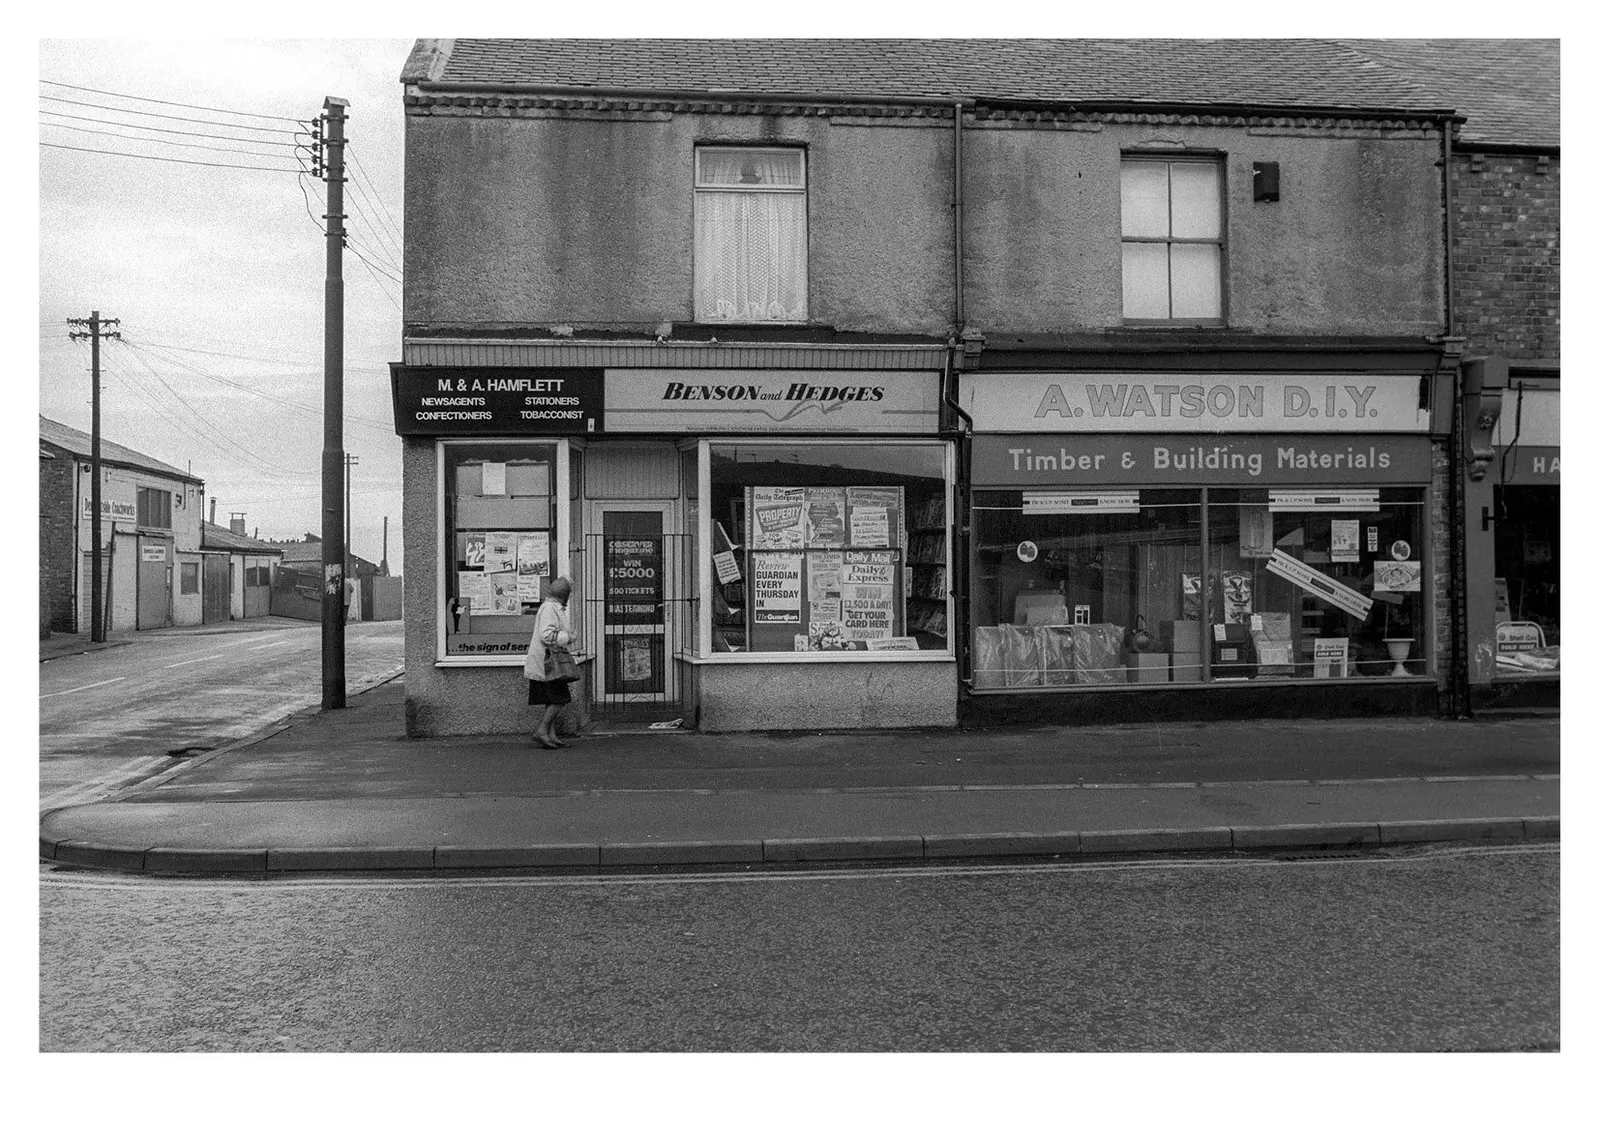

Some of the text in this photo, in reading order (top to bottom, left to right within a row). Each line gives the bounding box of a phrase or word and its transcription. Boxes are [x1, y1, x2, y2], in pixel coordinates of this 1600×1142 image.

[438, 378, 564, 392] M. & A. HAMFLETT
[662, 382, 885, 402] BENSON and HEDGES
[421, 397, 486, 407] NEWSAGENTS
[525, 396, 580, 406] STATIONERS
[1283, 385, 1378, 419] D.I.Y.
[415, 411, 493, 421] CONFECTIONERS
[520, 410, 584, 420] TOBACCONIST
[1008, 446, 1391, 477] Timber & Building Materials
[773, 493, 804, 502] Telegraph
[759, 506, 802, 524] PROPERTY
[847, 551, 891, 563] Daily Mail
[756, 560, 789, 571] Review
[852, 565, 880, 575] Daily
[609, 567, 655, 578] £5000
[756, 571, 799, 580] GUARDIAN
[848, 573, 889, 583] Express
[756, 581, 784, 589] EVERY
[624, 587, 655, 595] TICKETS
[756, 590, 800, 599] THURSDAY
[756, 600, 765, 608] IN
[869, 600, 875, 609] A
[848, 611, 863, 620] GET
[864, 611, 886, 620] YOUR
[845, 619, 868, 628] CARD
[869, 620, 889, 628] HERE
[477, 642, 499, 655] sign
[500, 642, 511, 653] of
[511, 644, 530, 653] ser
